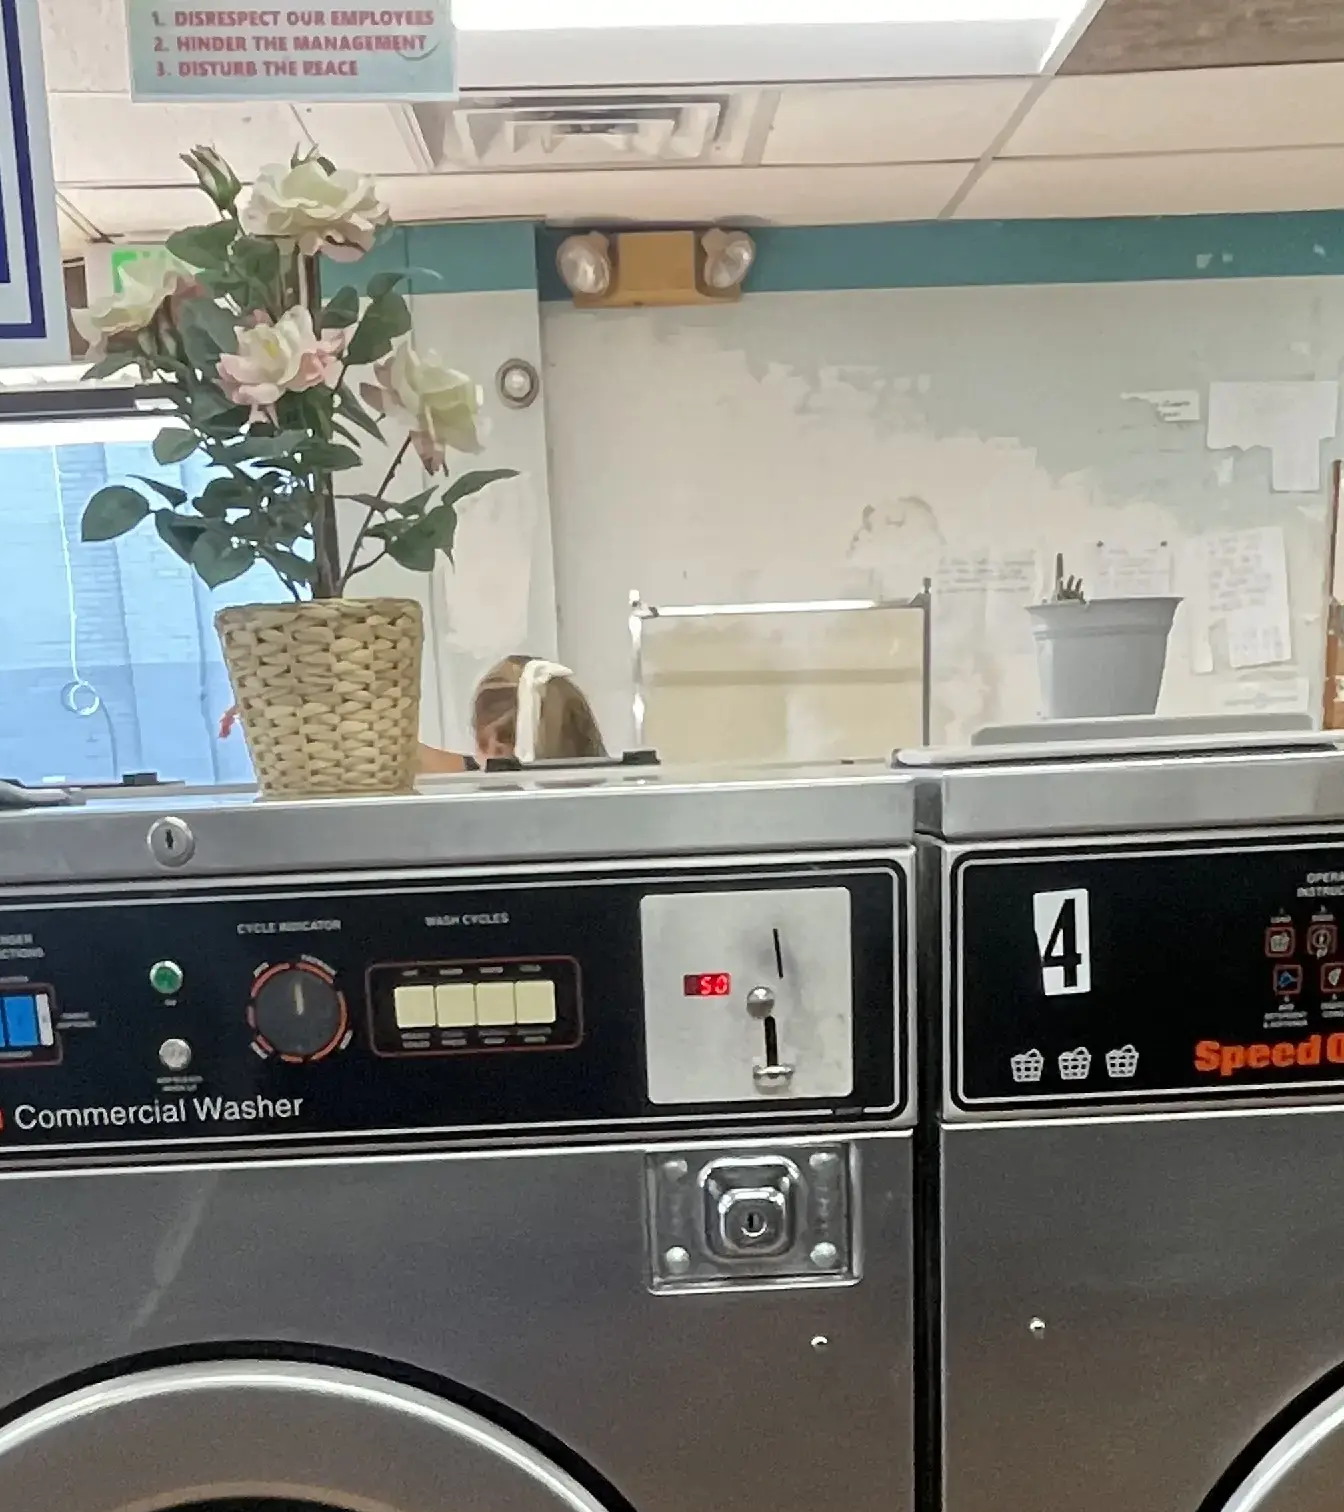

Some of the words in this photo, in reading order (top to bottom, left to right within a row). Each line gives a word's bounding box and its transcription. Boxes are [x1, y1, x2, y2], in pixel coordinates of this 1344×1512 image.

[174, 11, 280, 26] DISRESPECT
[286, 11, 325, 26] OUR
[330, 11, 434, 26] EMPLOYEES
[153, 36, 169, 52] 2.
[176, 36, 247, 52] HINDER
[252, 36, 288, 51] THE
[293, 35, 426, 52] MANAGEMENT
[178, 61, 257, 76] DISTURB
[263, 61, 297, 76] THE
[302, 61, 358, 76] PEACE
[1044, 898, 1083, 988] 4
[1195, 1035, 1321, 1076] Speed
[14, 1097, 186, 1129] Commercial
[195, 1093, 304, 1120] Washer
